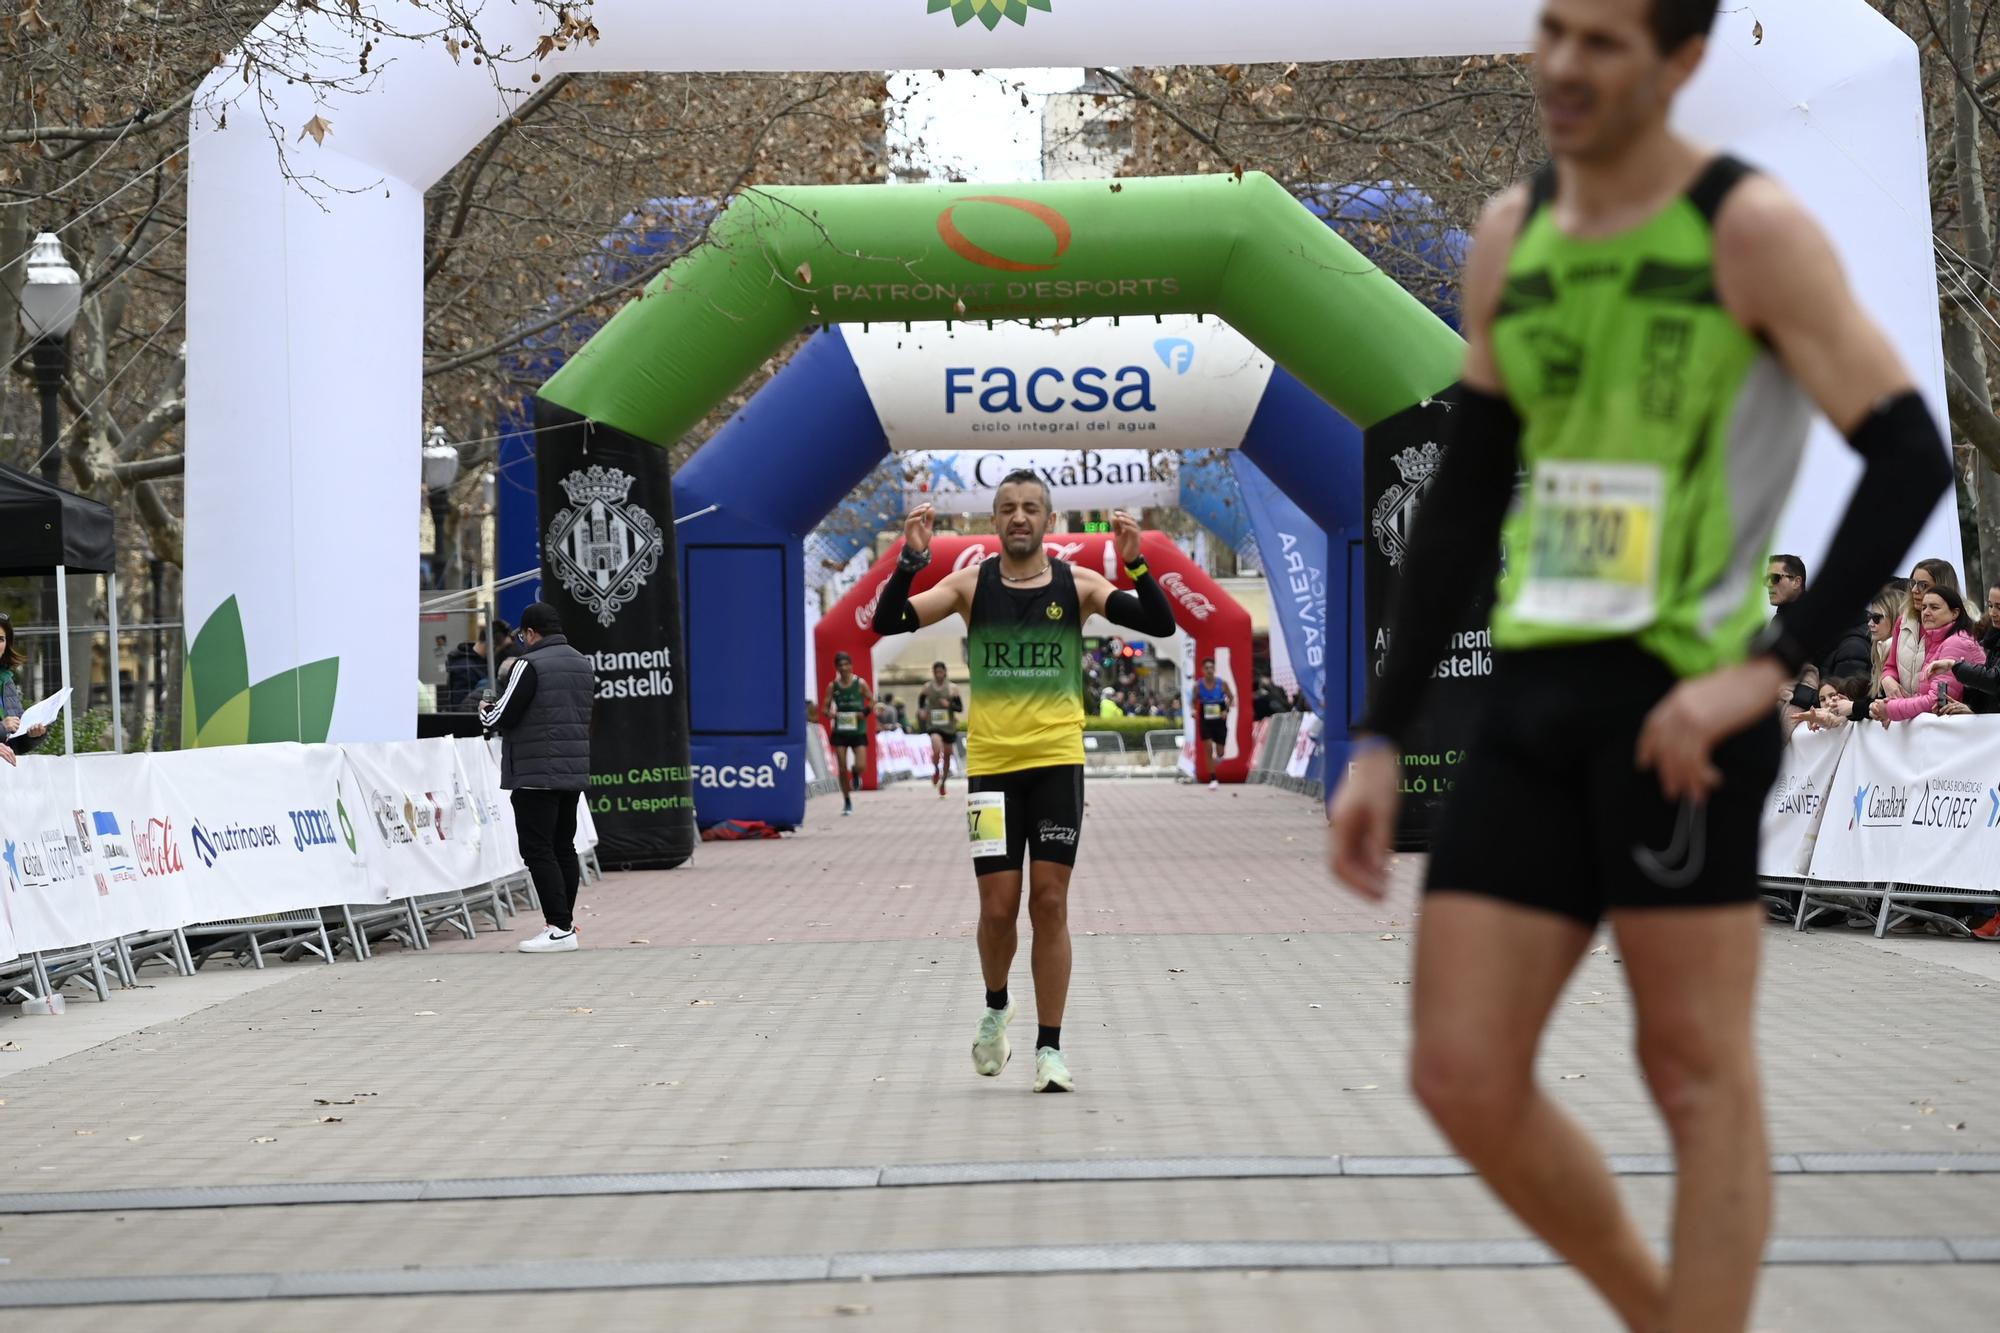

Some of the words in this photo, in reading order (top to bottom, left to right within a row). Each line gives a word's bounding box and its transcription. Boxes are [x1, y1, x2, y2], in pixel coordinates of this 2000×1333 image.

[832, 283, 995, 301] PATRONAT
[1007, 277, 1180, 299] D'ESPORTS
[945, 365, 1157, 413] Facsa
[971, 421, 1011, 432] ciclo
[1017, 421, 1080, 433] integral
[1086, 420, 1111, 431] del
[1117, 421, 1157, 433] agua
[974, 449, 1167, 489] CxaBank
[586, 646, 672, 671] ntament
[1431, 650, 1492, 678] stelló
[987, 669, 1011, 677] GOOD
[1012, 669, 1034, 677] VIBES
[1404, 753, 1440, 766] mou
[627, 767, 692, 784] CASTELL
[617, 795, 678, 812] L'esport
[1867, 785, 1908, 819] CaixaBank
[1911, 780, 1978, 830] ASCIRES
[211, 822, 281, 852] nutrinovex
